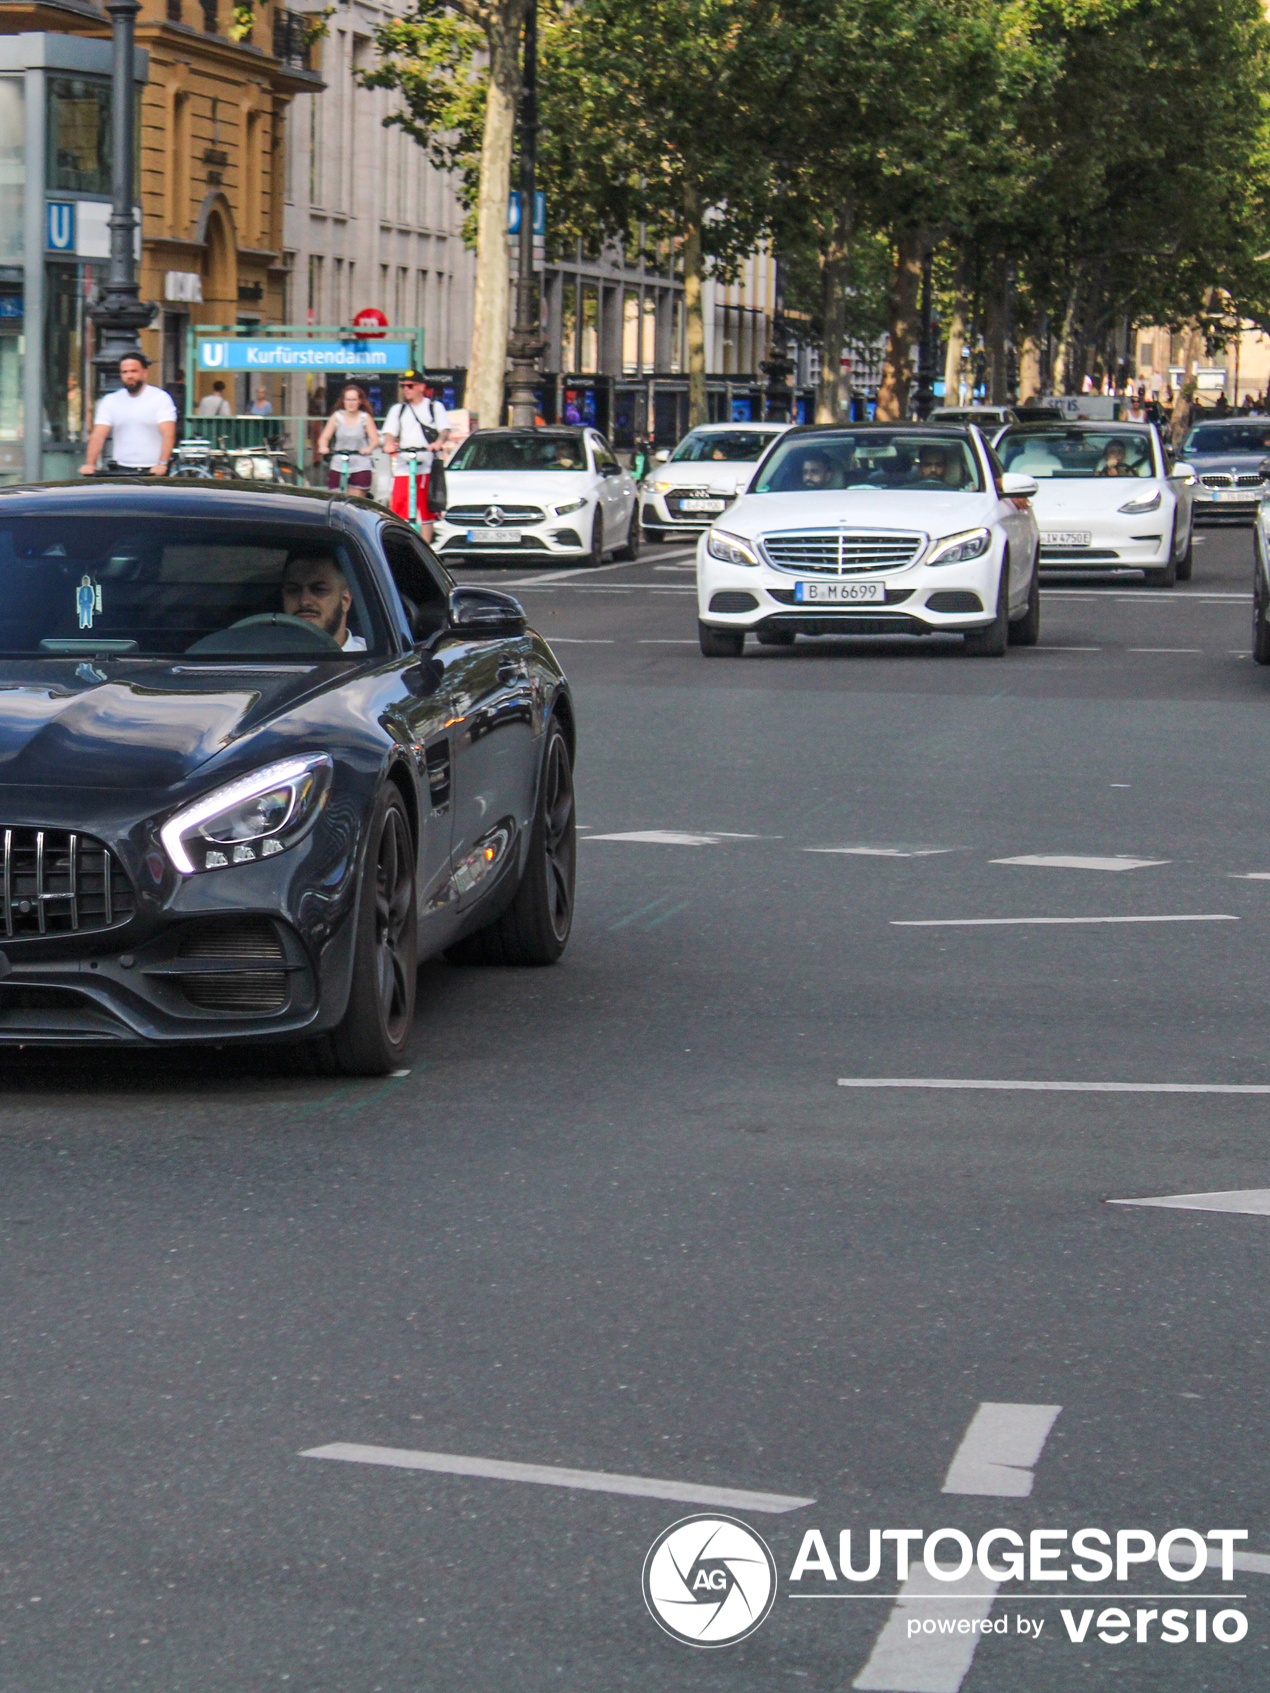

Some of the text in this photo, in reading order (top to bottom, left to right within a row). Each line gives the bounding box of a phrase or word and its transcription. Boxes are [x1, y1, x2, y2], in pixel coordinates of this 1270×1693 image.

[51, 205, 69, 248] U
[203, 343, 387, 367] U Kurfürstendamm
[809, 585, 877, 599] B M 6699
